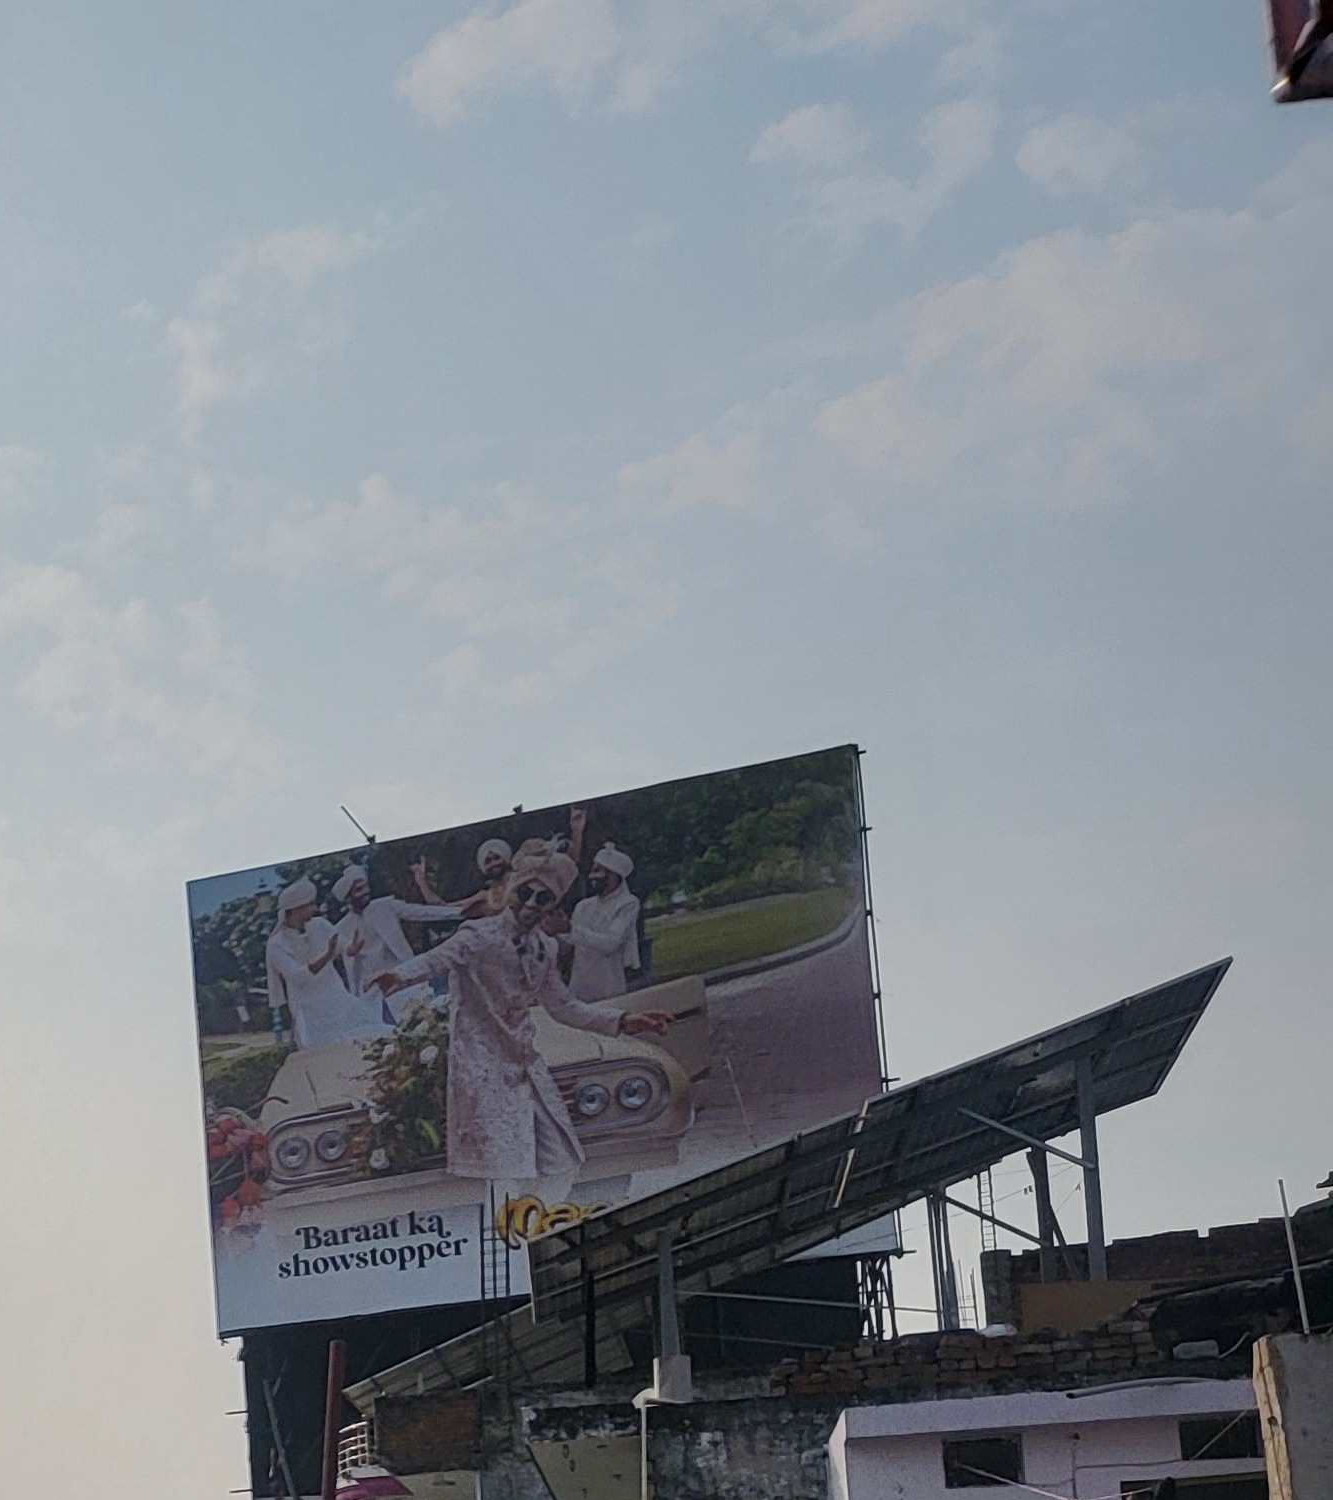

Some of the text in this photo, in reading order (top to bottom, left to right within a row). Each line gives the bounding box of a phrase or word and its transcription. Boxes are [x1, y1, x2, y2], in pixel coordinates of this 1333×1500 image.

[295, 1210, 452, 1250] Baraat ka
[278, 1237, 469, 1279] showstopper
